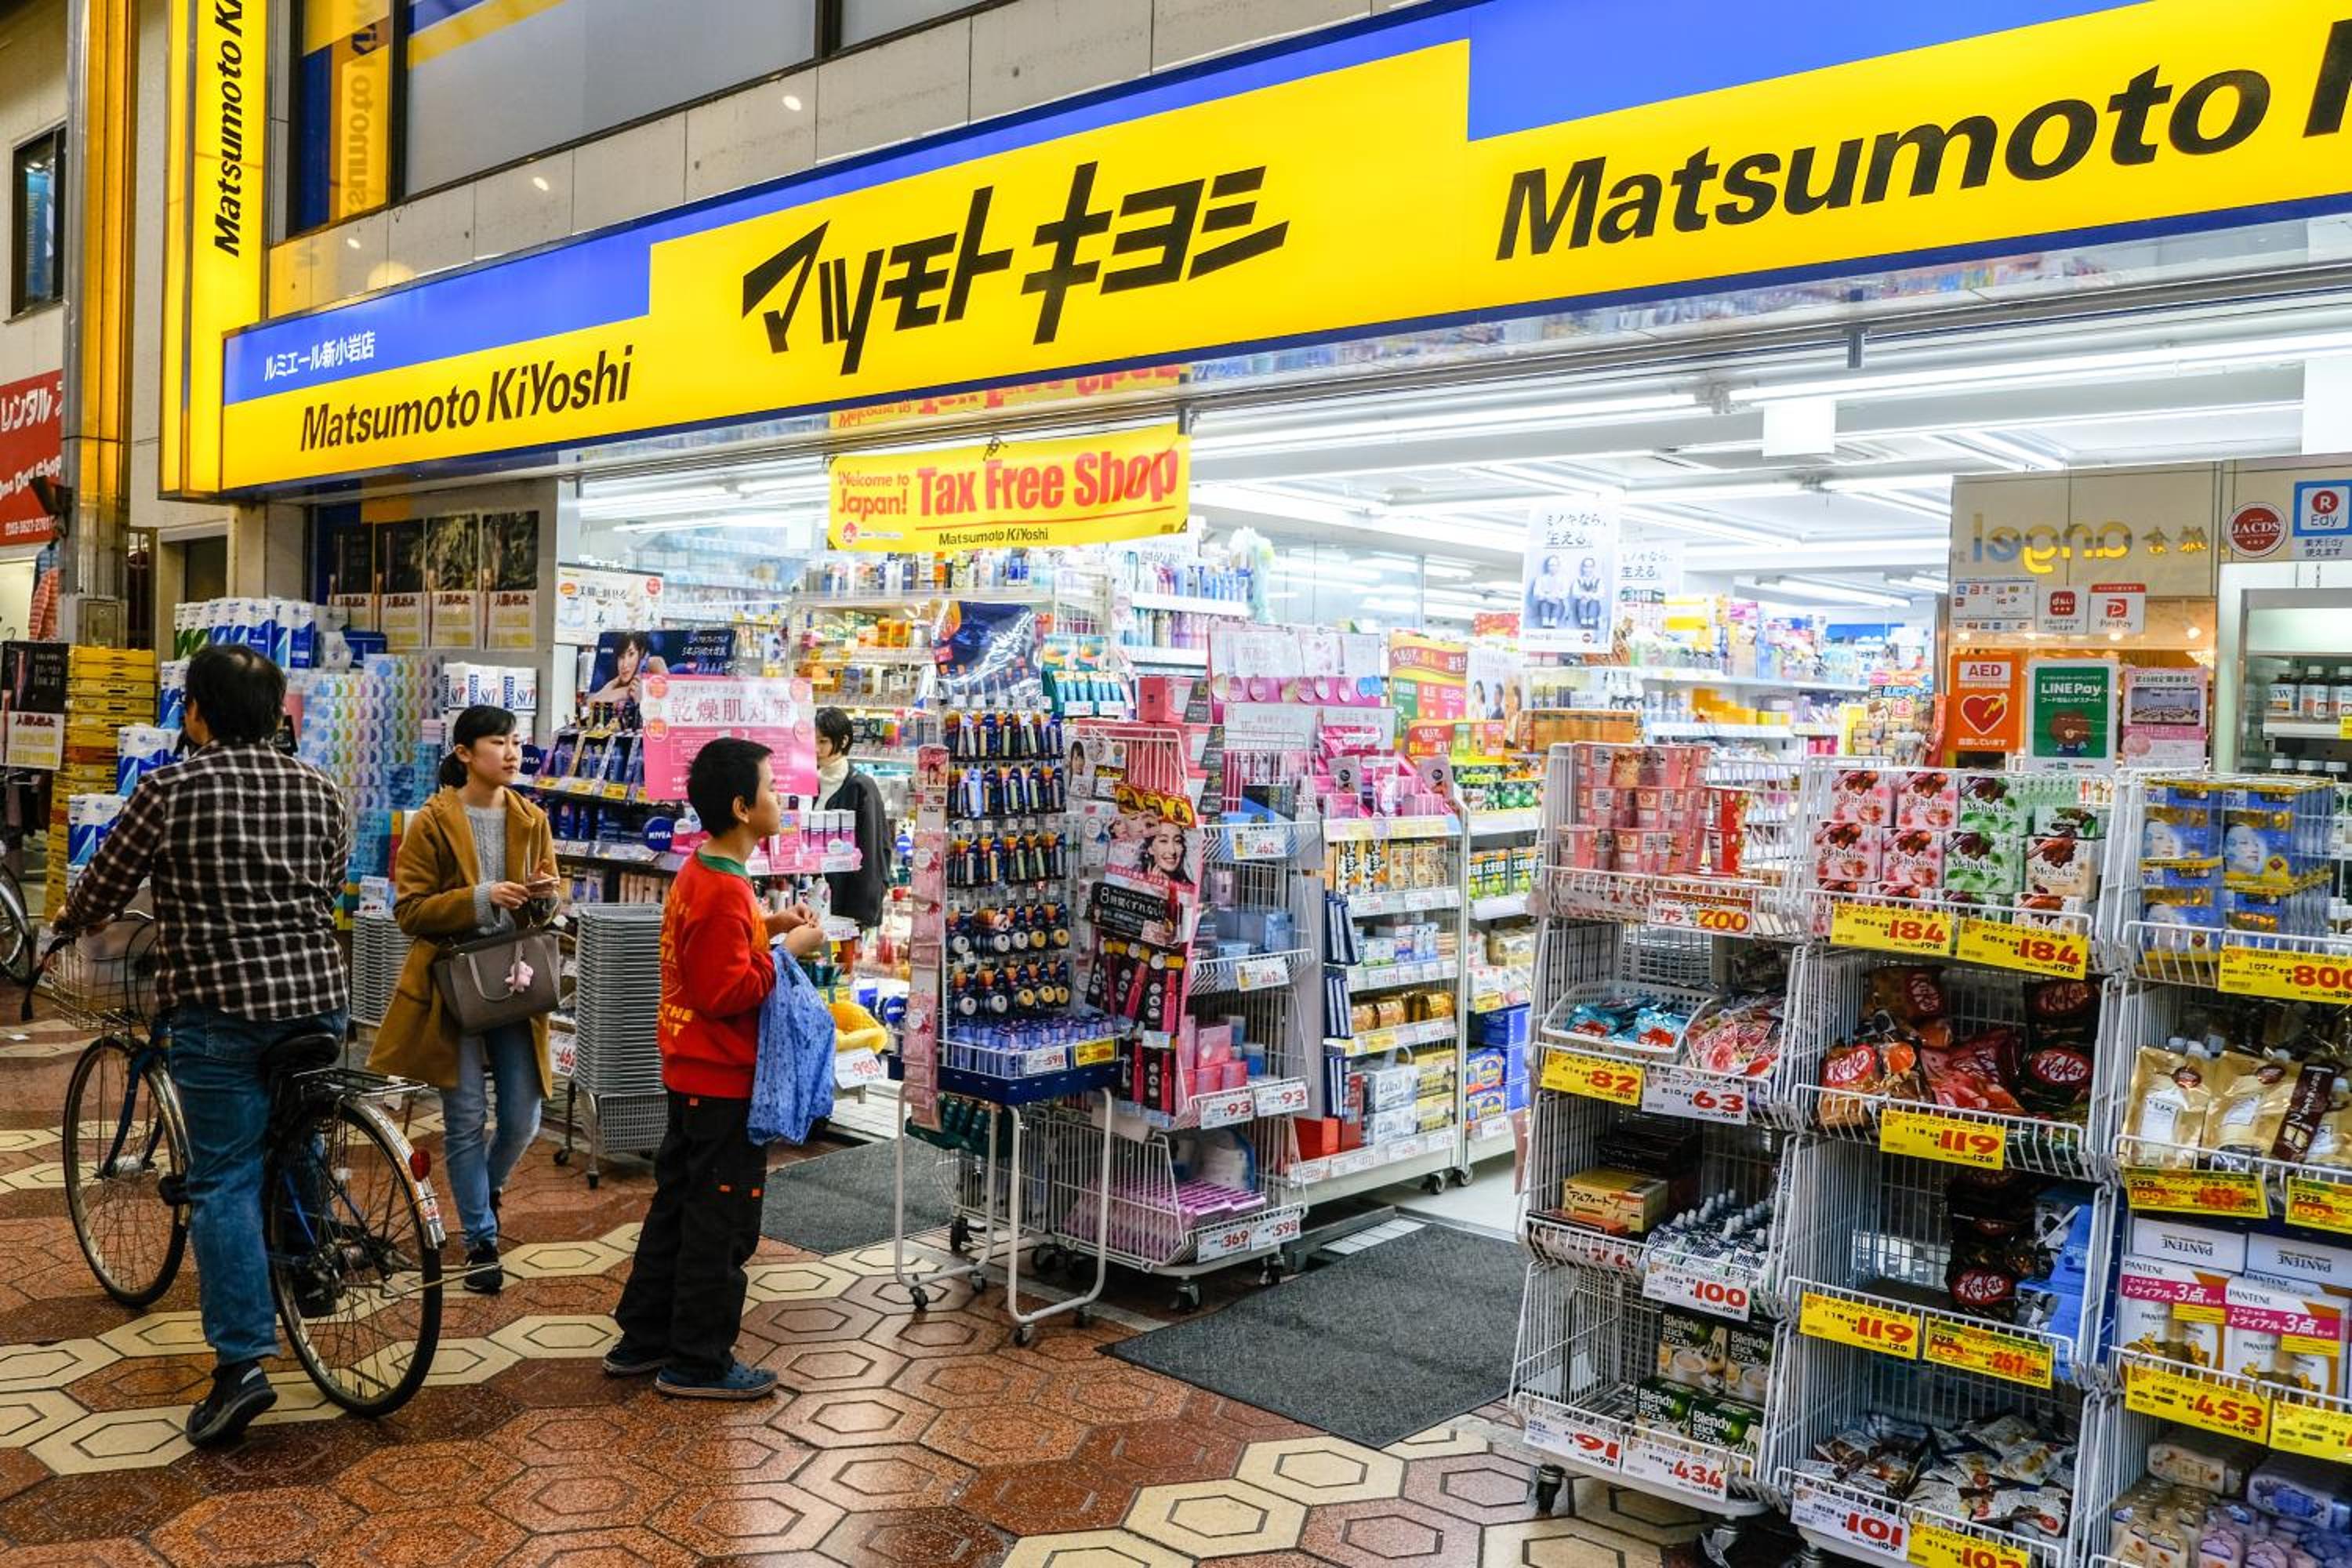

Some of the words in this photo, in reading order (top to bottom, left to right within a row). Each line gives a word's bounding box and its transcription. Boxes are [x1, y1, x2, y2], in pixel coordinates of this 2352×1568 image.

[214, 40, 242, 258] Matsumoto
[1496, 65, 2271, 261] Matsumoto
[742, 161, 1290, 376] マツモトキヨシ
[265, 331, 376, 382] ルミエール新小岩店
[300, 387, 479, 452] Matsumoto
[487, 345, 633, 424] KiYoshi
[838, 470, 893, 489] Welcome
[898, 474, 909, 486] to
[916, 466, 976, 516] Tax
[985, 459, 1065, 510] Free
[1073, 449, 1179, 507] Shop
[838, 489, 908, 522] Japan!
[2232, 521, 2281, 535] JACDS
[2310, 514, 2339, 528] Edy
[939, 531, 1004, 546] Matsumoto
[1968, 664, 2002, 677] AED
[2042, 683, 2074, 694] LINE
[2074, 683, 2102, 696] Pay
[670, 697, 791, 723] 乾燥肌対策
[648, 831, 673, 840] NIVEA
[1698, 909, 1749, 932] 200
[1889, 920, 1946, 942] 184
[2020, 938, 2082, 965] 184
[1828, 1048, 1871, 1083] KitKat
[2039, 1055, 2085, 1080] KitKat
[1591, 1069, 1638, 1093] 82
[1282, 1089, 1306, 1104] 93
[1693, 1091, 1744, 1112] 63
[1228, 1101, 1252, 1116] 93
[1940, 1129, 1999, 1154] 119
[1569, 1189, 1613, 1206] アルフォート
[1222, 1230, 1249, 1247] 369
[2161, 1238, 2213, 1256] PANTENE
[2124, 1260, 2164, 1276] PANTENE
[2278, 1254, 2332, 1273] PANTENE
[1694, 1280, 1747, 1307] 100
[2228, 1289, 2270, 1305] PANTENE
[1663, 1313, 1700, 1334] Blendy
[1663, 1327, 1685, 1338] stick
[1857, 1316, 1914, 1342] 119
[1730, 1330, 1771, 1349] Blendy
[1730, 1344, 1753, 1356] stick
[1639, 1387, 1676, 1409] Blendy
[1639, 1399, 1661, 1414] stick
[1693, 1410, 1732, 1432] Blendy
[2195, 1395, 2263, 1428] 453
[1692, 1422, 1715, 1436] stick
[1574, 1433, 1619, 1460] 91
[1674, 1459, 1723, 1489] 434
[1847, 1512, 1904, 1547] 101
